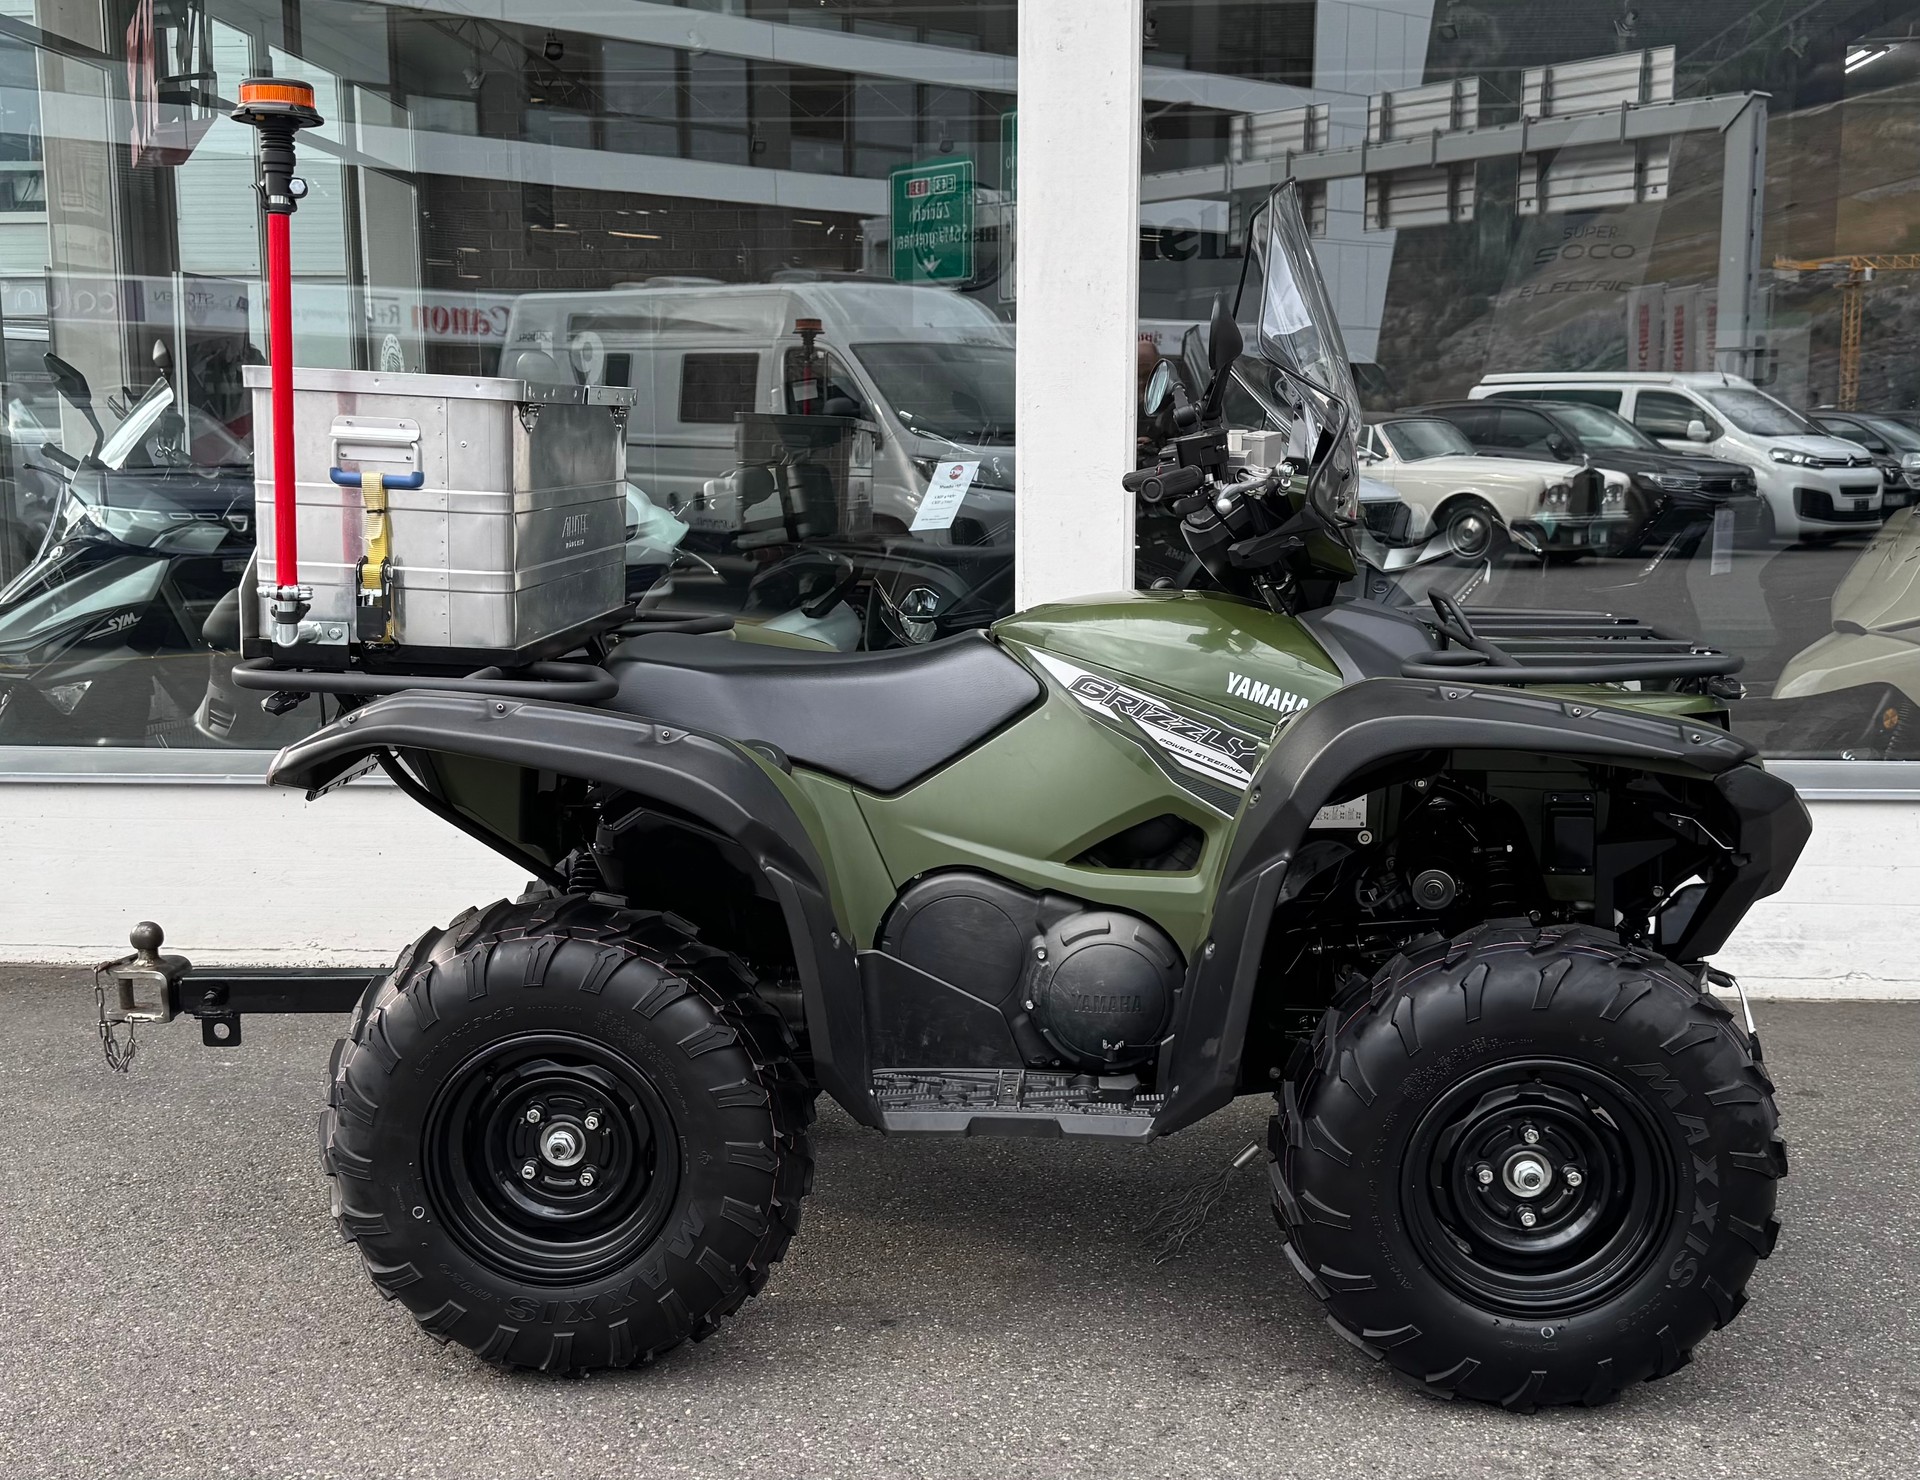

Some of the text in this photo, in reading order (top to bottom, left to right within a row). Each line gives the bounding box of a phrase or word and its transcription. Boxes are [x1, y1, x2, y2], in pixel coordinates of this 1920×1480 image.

[1562, 225, 1619, 240] SUPER
[1534, 244, 1636, 265] SOCO
[1517, 280, 1633, 299] ELECTRIC
[99, 612, 142, 635] SYM
[1226, 671, 1309, 713] YAMAHA
[1067, 674, 1257, 757] GRIZZLY
[1158, 737, 1245, 774] POWER STEERING
[1071, 993, 1143, 1013] YAMAHA
[1623, 1062, 1720, 1288] MAXXIS
[504, 1200, 705, 1323] MAXXIS
